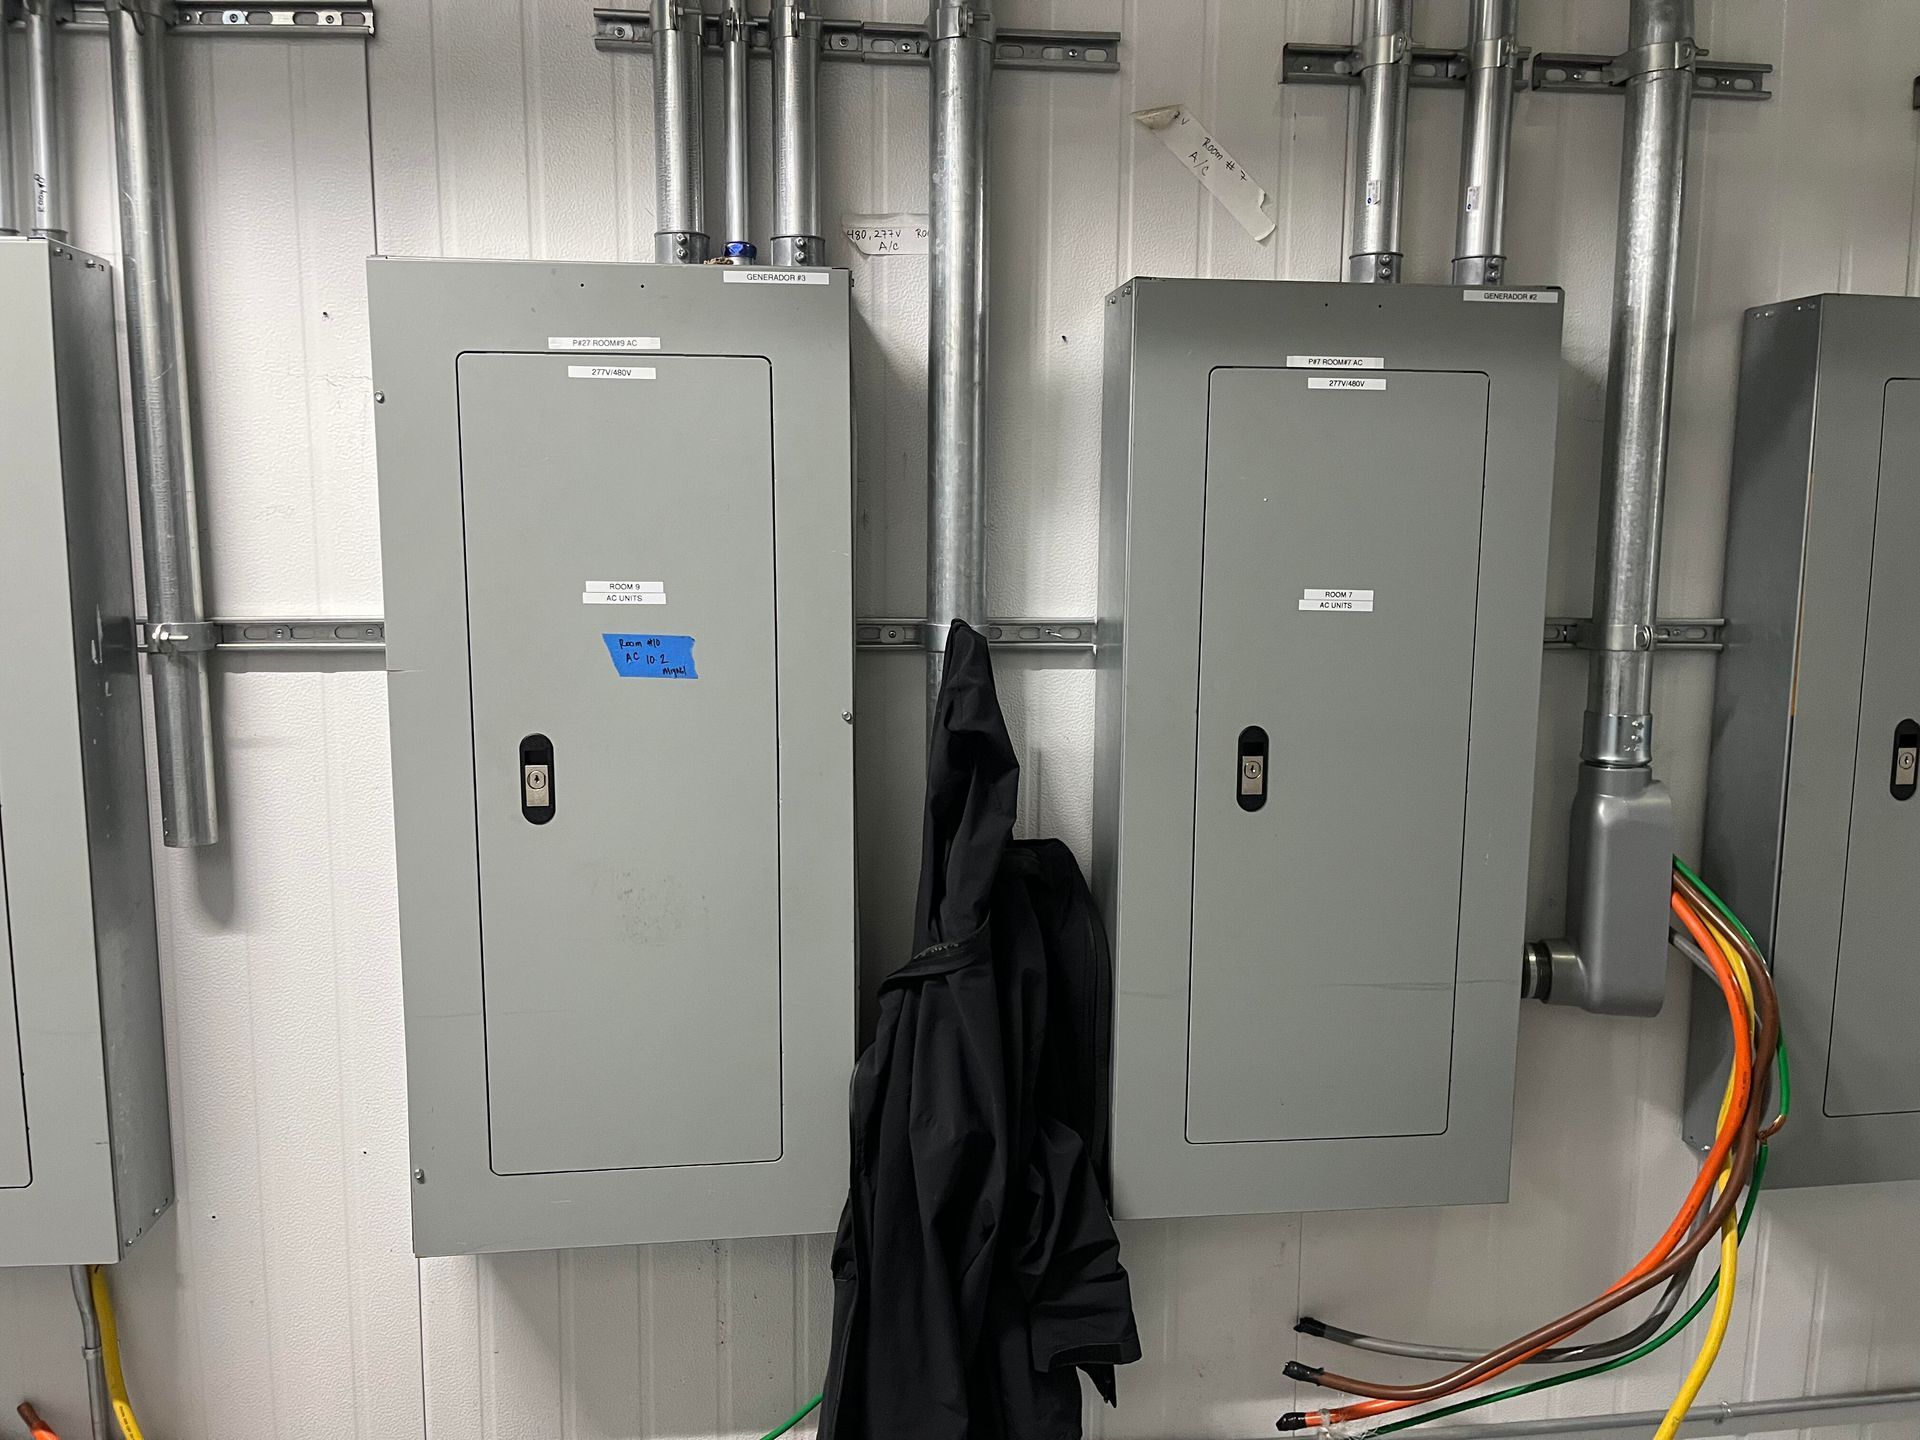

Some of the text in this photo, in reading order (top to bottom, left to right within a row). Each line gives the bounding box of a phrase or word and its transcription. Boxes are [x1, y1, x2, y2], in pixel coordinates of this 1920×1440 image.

[878, 240, 899, 253] A/C
[746, 273, 806, 282] GENERADOR #3
[1483, 292, 1538, 301] GENERADOR #2
[572, 339, 638, 348] P#27 ROOM#9 AC
[1322, 358, 1352, 366] ROOM#7
[591, 368, 632, 377] 277V/480V
[1329, 380, 1365, 388] 277V/480V
[606, 594, 643, 602] AC UNITS
[1348, 591, 1353, 599] 7
